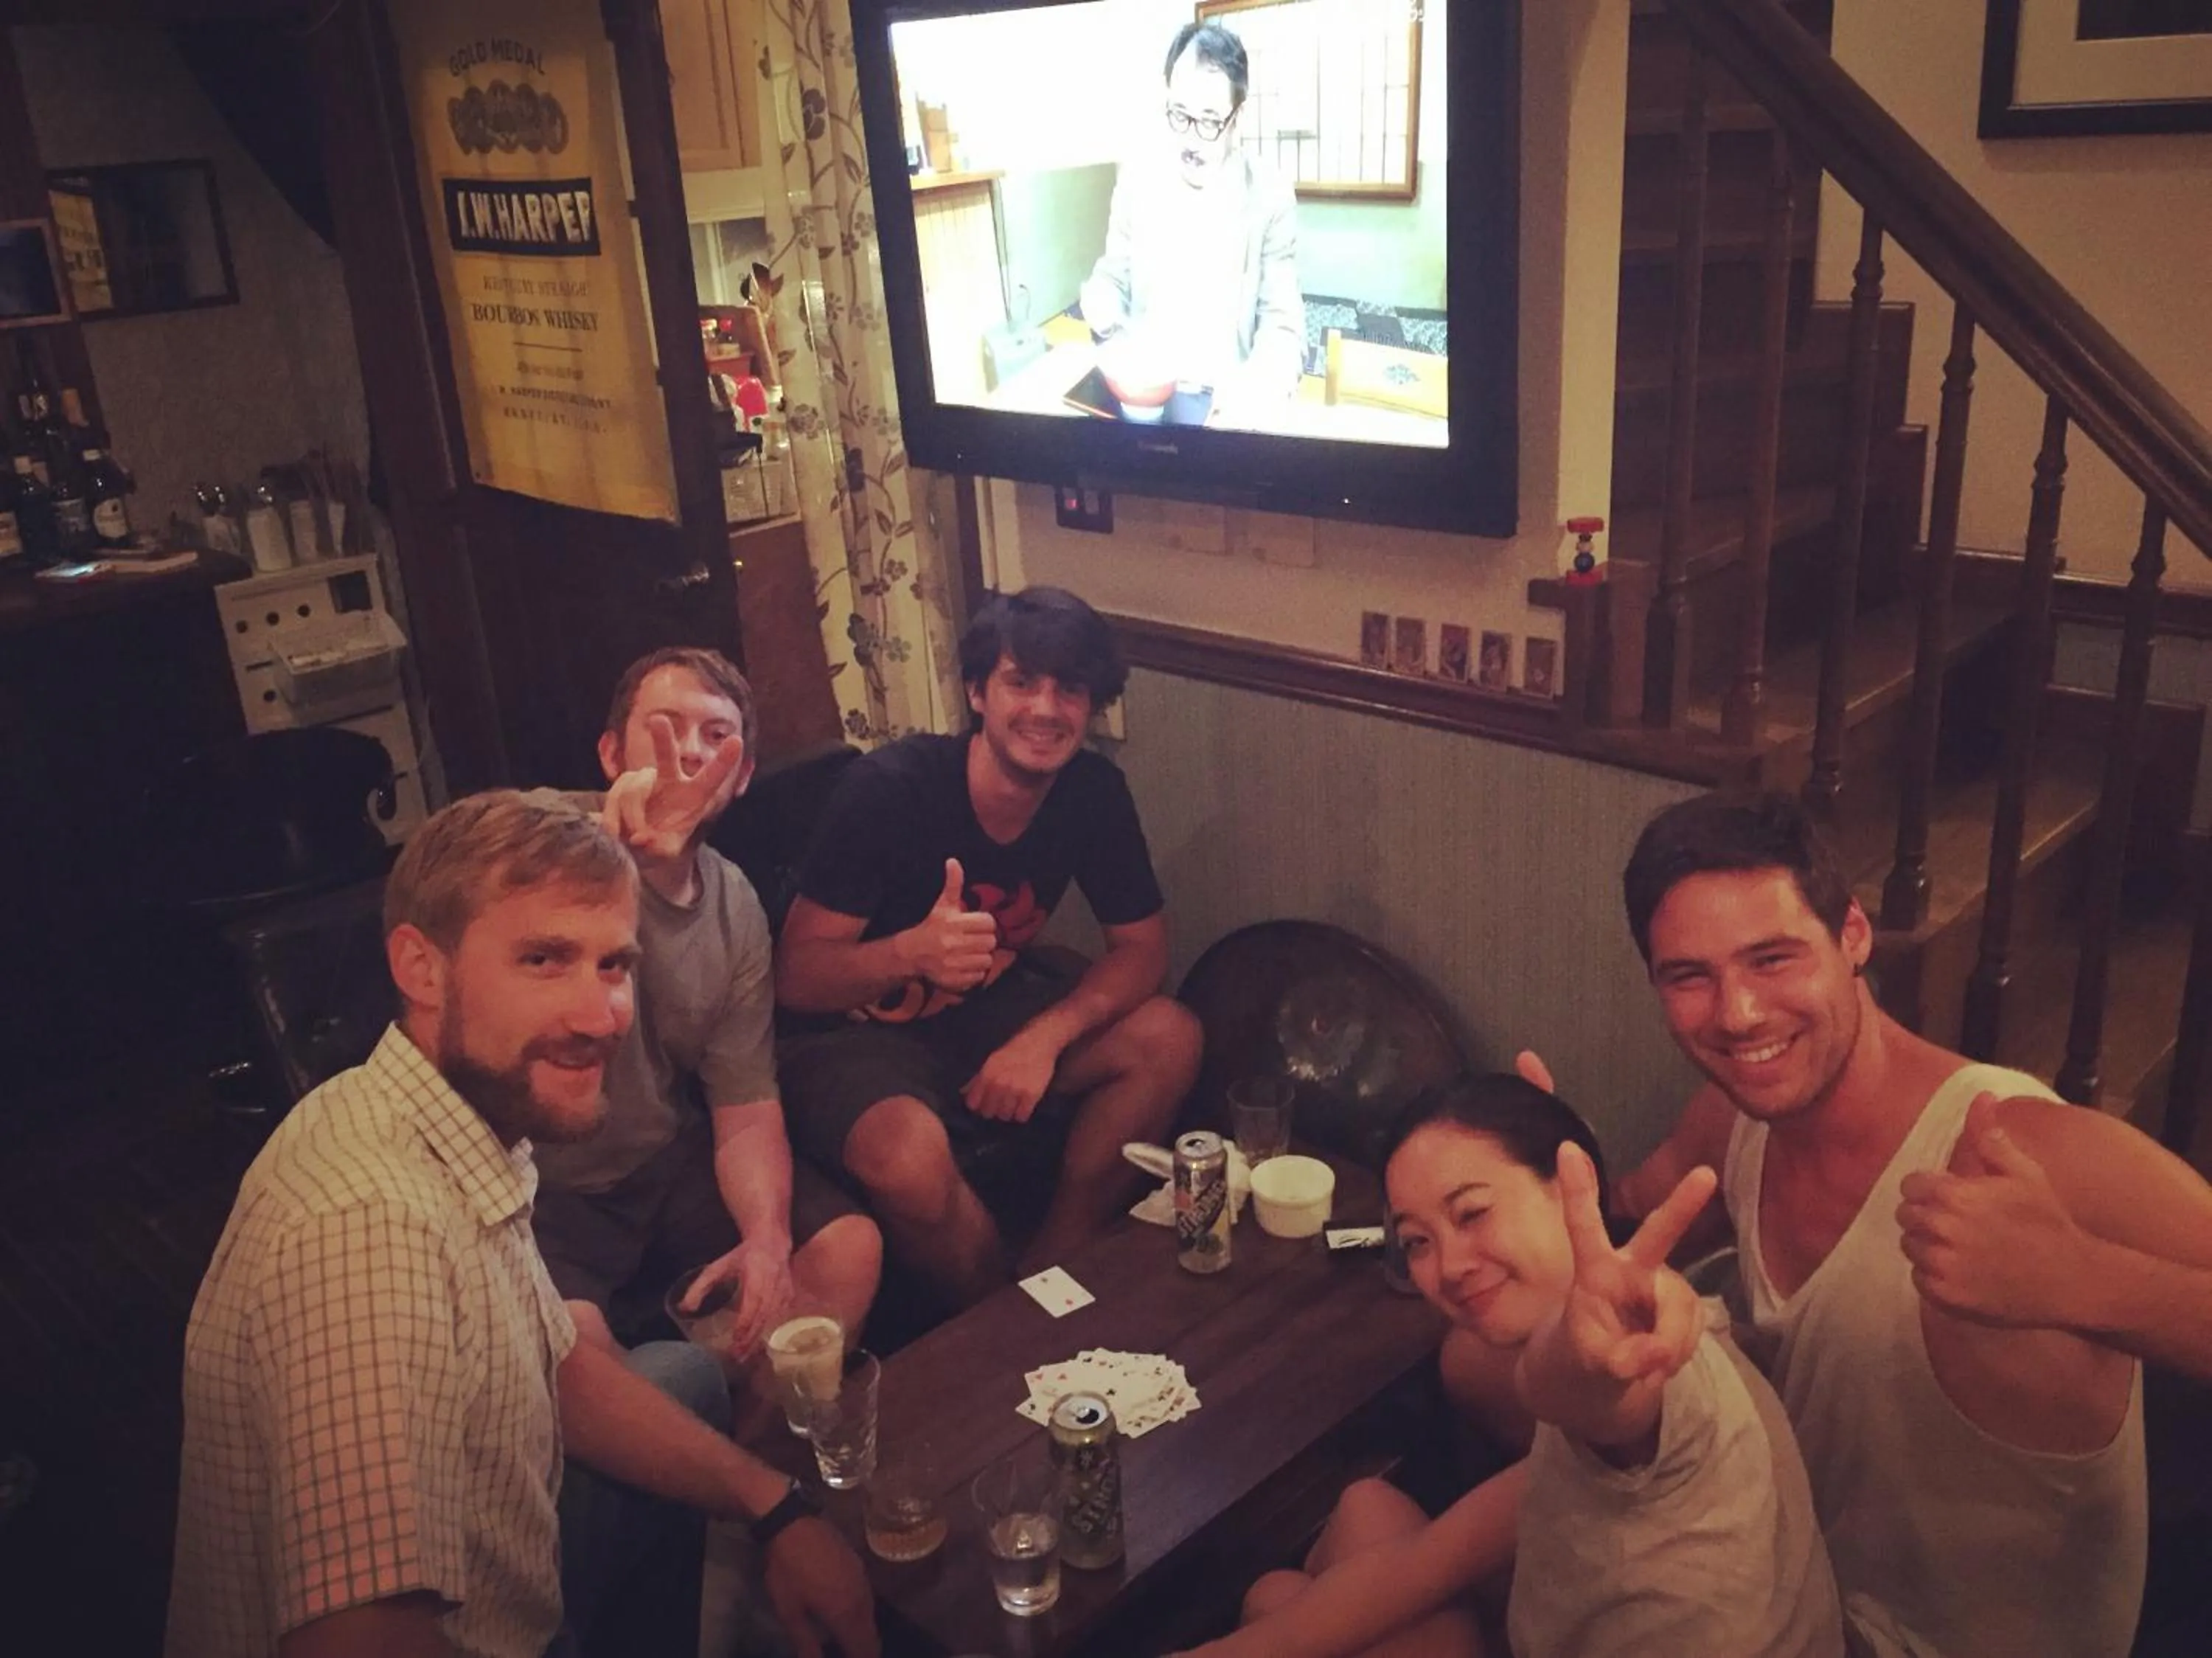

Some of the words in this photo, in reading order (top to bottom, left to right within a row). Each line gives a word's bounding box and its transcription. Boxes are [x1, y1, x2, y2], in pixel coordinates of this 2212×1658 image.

[449, 41, 487, 77] GOLD
[490, 35, 546, 75] MEDAL
[472, 303, 541, 325] BOURBON
